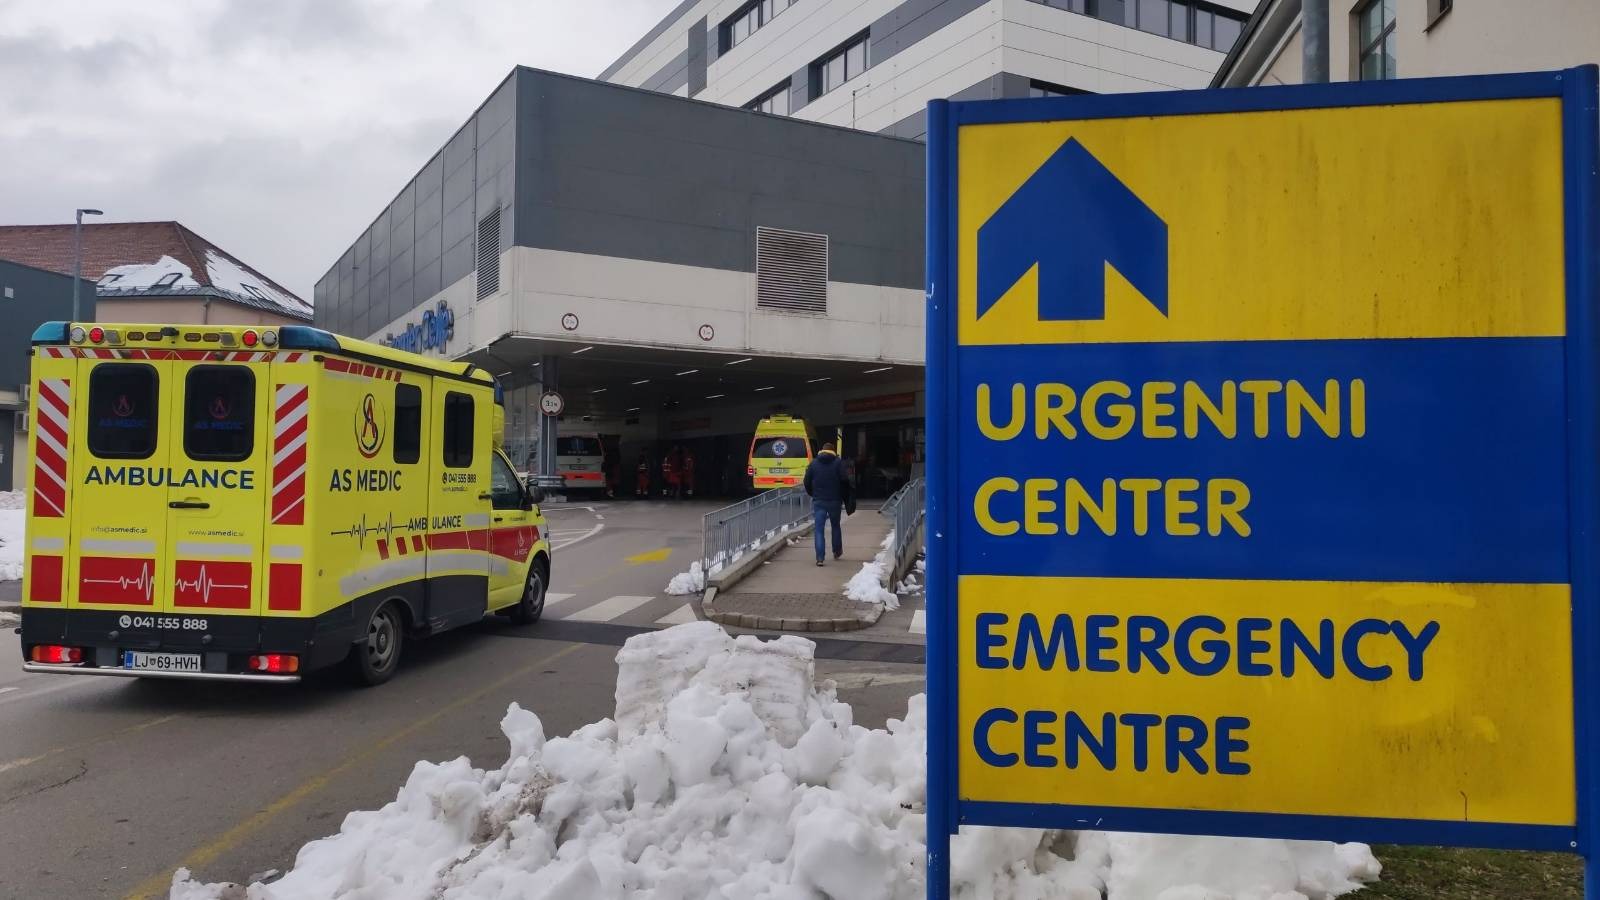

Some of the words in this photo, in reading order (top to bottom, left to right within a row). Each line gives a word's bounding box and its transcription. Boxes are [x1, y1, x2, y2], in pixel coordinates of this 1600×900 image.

[976, 379, 1366, 440] URGENTNI
[84, 465, 255, 490] AMBULANCE
[329, 469, 352, 492] AS
[356, 470, 402, 492] MEDIC
[974, 477, 1252, 537] CENTER
[408, 515, 461, 532] AMBULANCE
[133, 616, 154, 628] 041
[157, 618, 180, 629] 555
[182, 619, 208, 631] 888
[976, 613, 1440, 681] EMERGENCY
[134, 655, 149, 668] LJ
[157, 656, 198, 670] 69-HVH
[973, 708, 1251, 776] CENTRE
